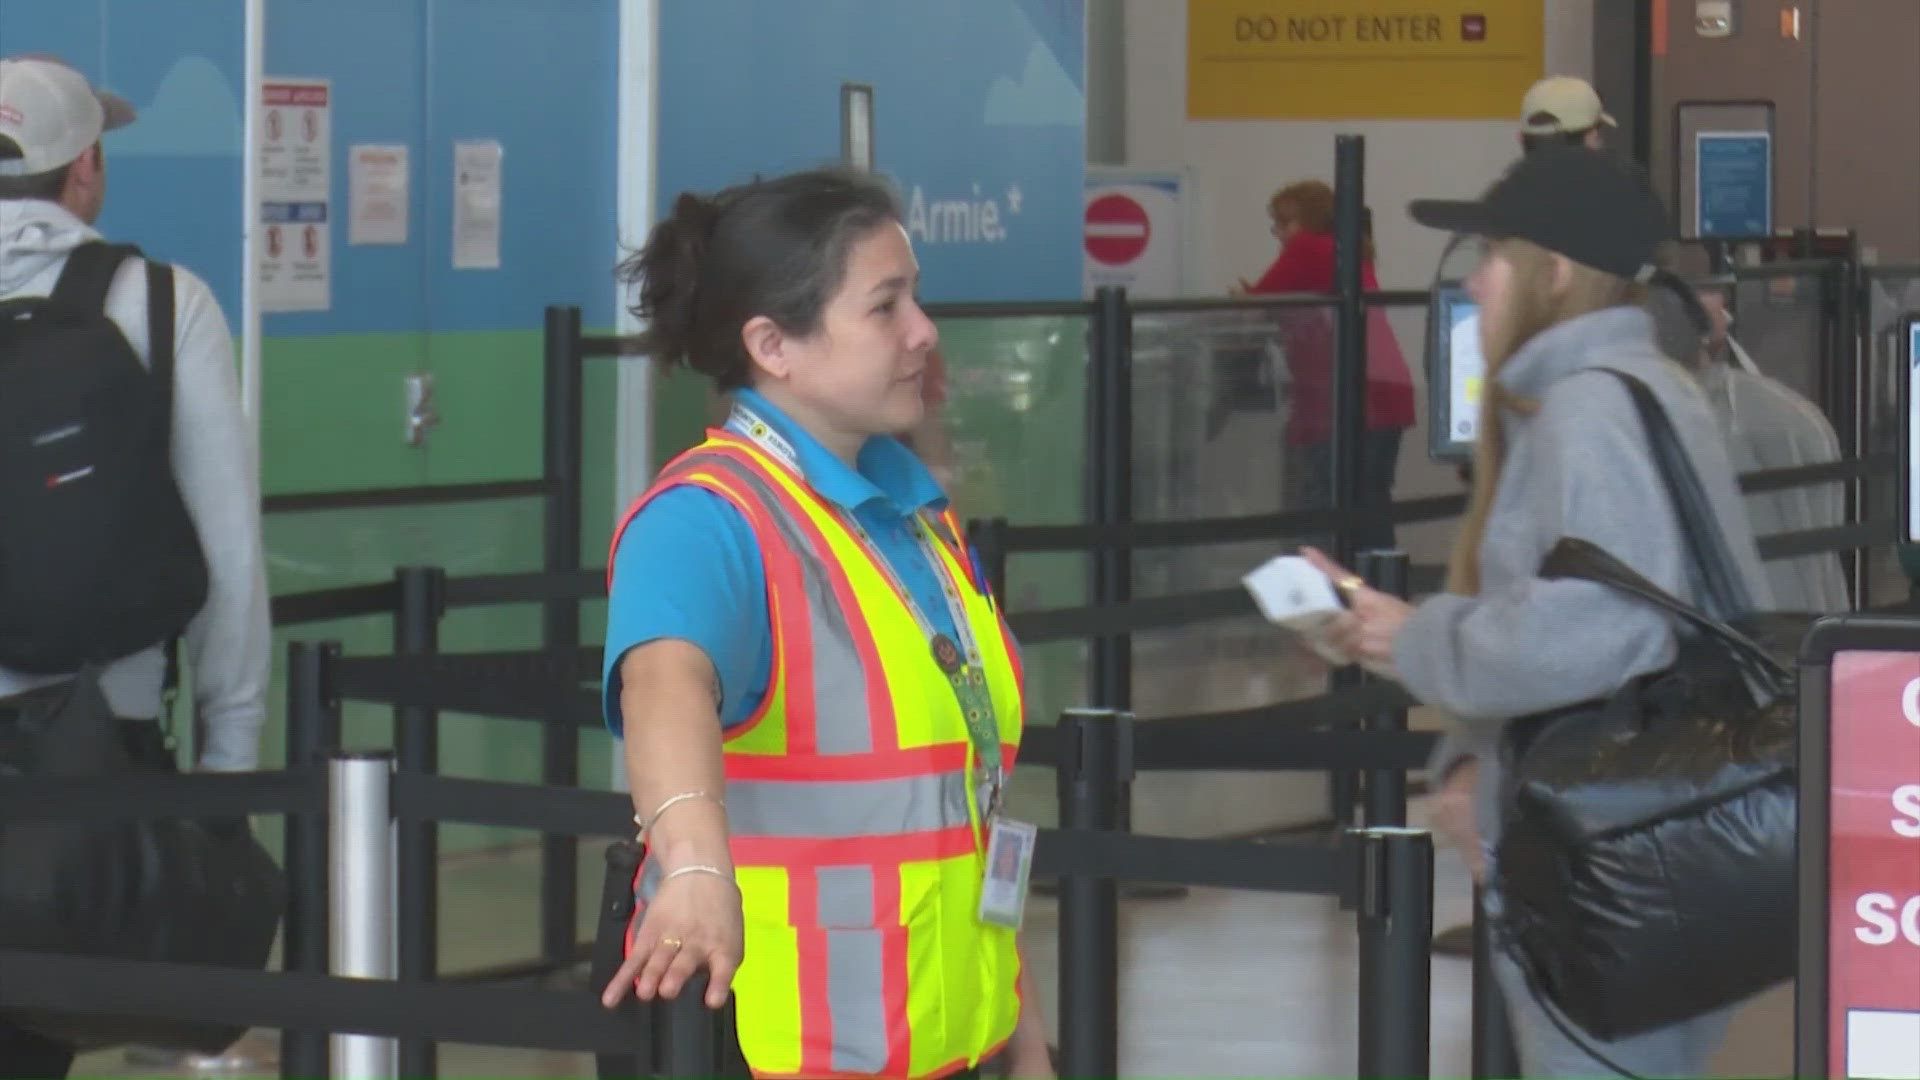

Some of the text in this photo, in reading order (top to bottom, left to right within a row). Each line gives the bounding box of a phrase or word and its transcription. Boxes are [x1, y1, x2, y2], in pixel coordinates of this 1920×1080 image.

[1234, 15, 1442, 42] DO NOT ENTER
